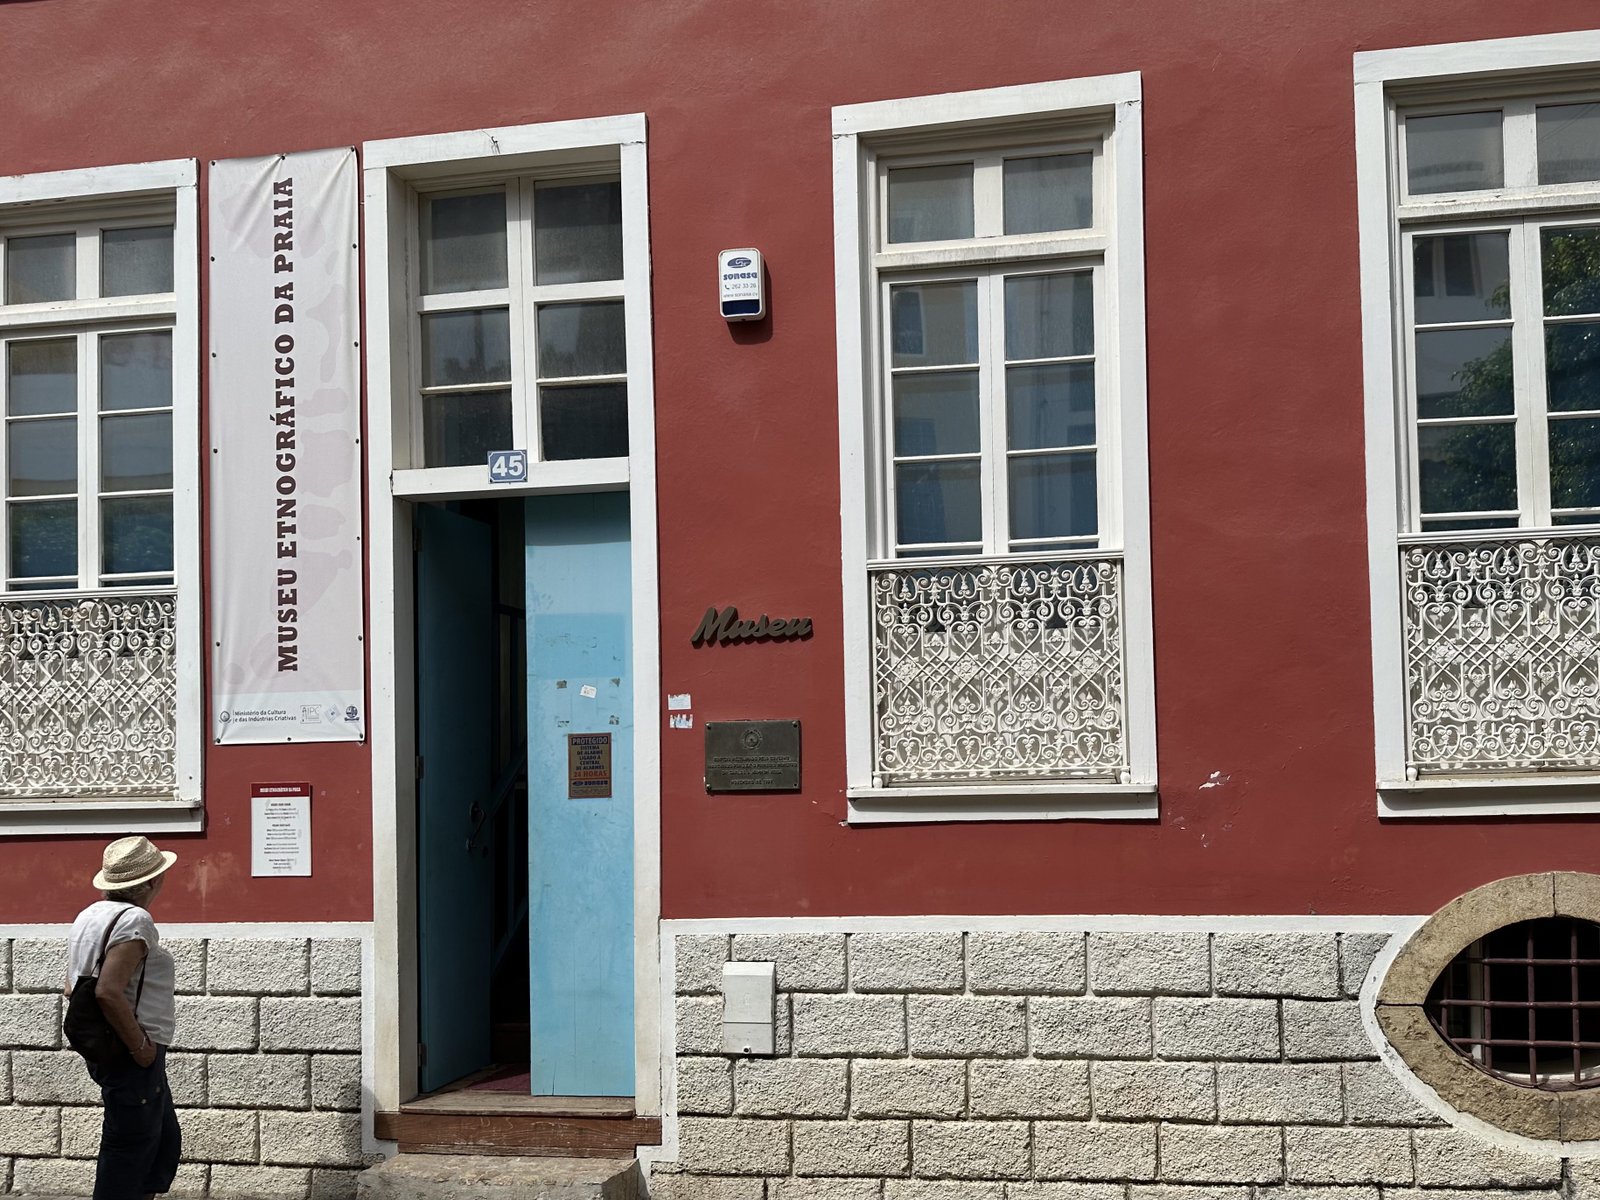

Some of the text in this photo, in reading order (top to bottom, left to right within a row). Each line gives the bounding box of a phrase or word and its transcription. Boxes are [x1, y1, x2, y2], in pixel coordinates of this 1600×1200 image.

[723, 272, 758, 280] sonasa
[270, 177, 298, 672] MUSEU ETNOGRÁFICO DA PRAIA
[492, 454, 523, 477] 45
[691, 606, 813, 645] Museu
